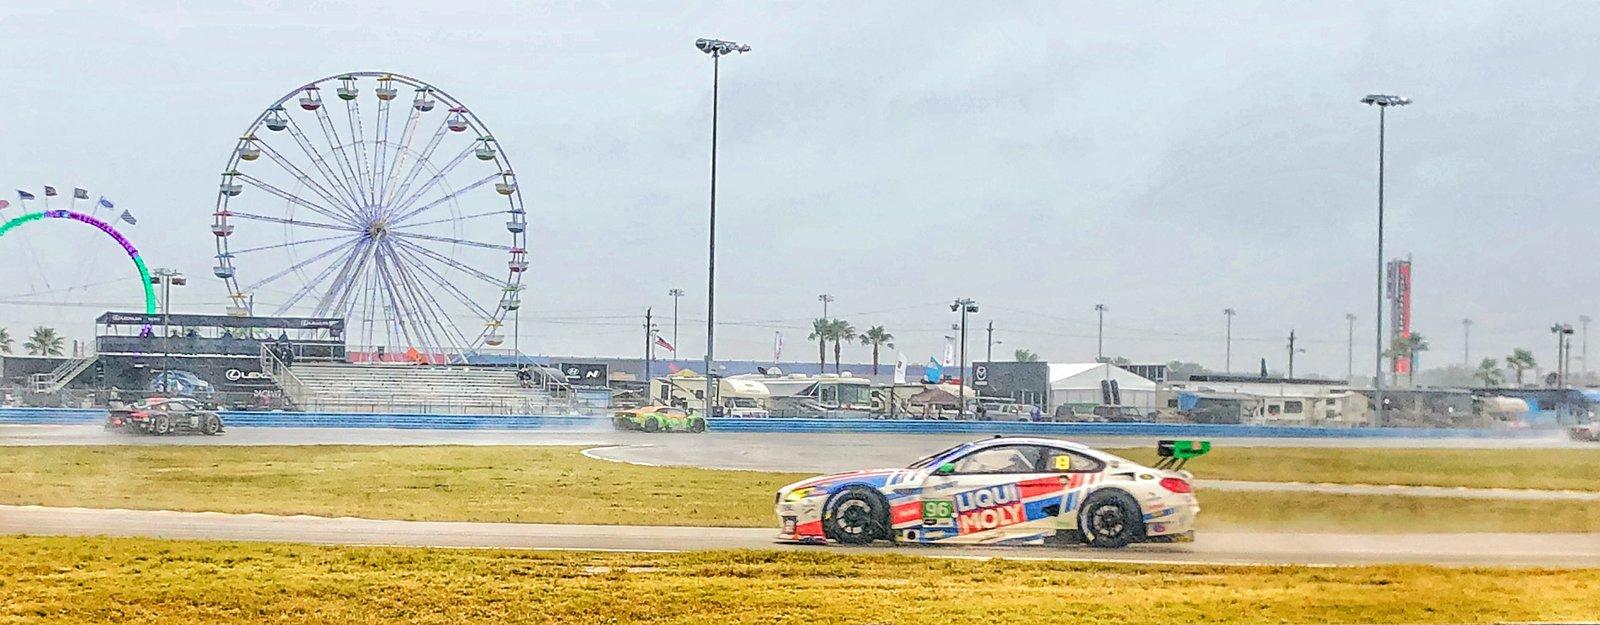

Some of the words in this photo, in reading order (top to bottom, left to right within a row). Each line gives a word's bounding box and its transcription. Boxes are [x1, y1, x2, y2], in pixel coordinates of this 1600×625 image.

[925, 502, 949, 517] 96
[955, 483, 1019, 512] LIQUI
[959, 503, 1023, 536] MOLY
